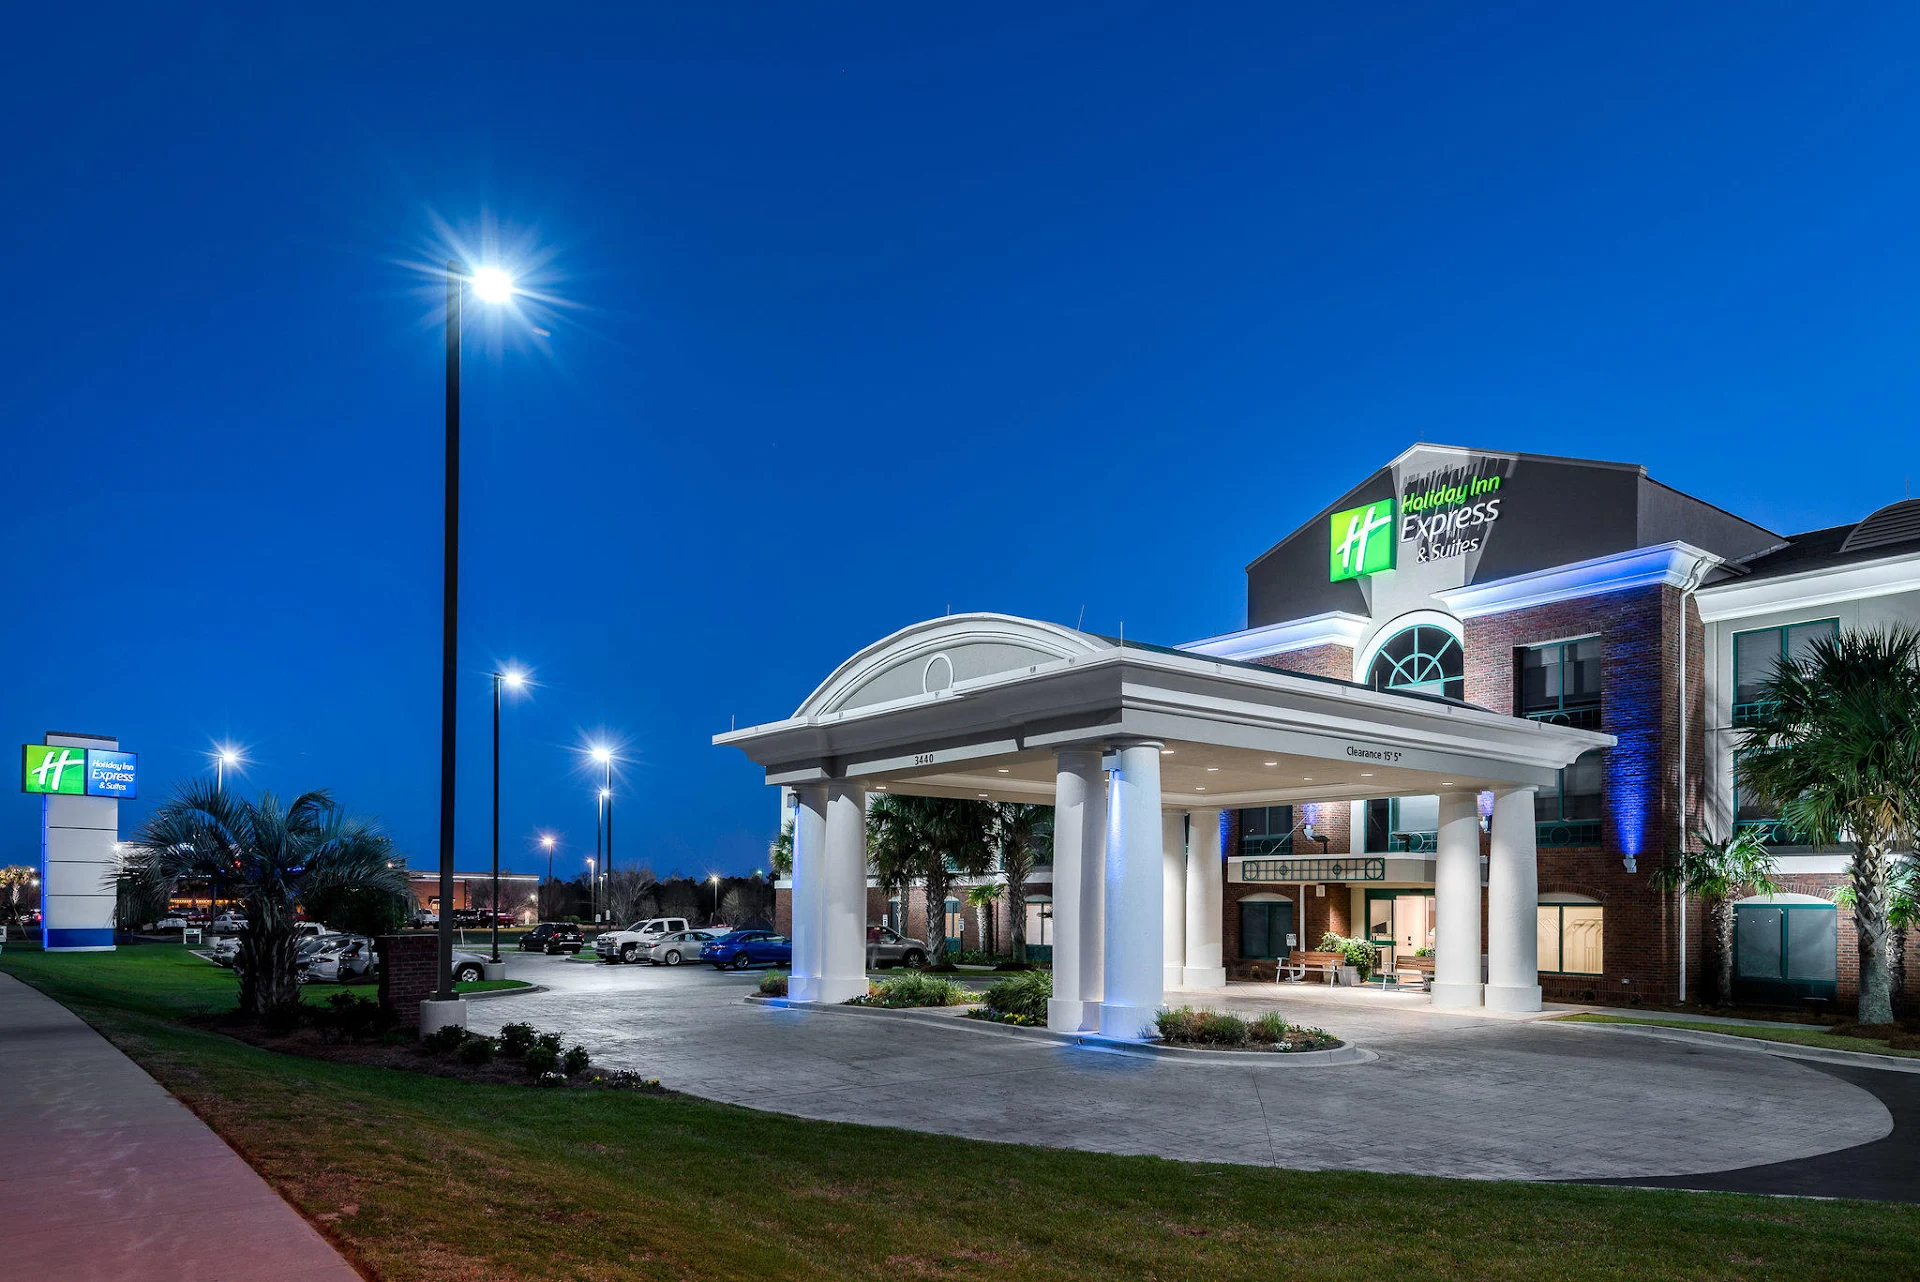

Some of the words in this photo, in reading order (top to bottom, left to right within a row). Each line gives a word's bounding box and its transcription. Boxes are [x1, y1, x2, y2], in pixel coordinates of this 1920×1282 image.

[1400, 484, 1469, 514] Holiday
[1470, 475, 1500, 496] Inn
[1400, 499, 1500, 543] Express
[1416, 547, 1429, 564] &
[1430, 538, 1479, 561] Suites
[914, 753, 934, 766] 3440
[1346, 745, 1382, 760] Clearance
[92, 760, 122, 771] Holiday
[122, 762, 134, 771] Inn
[92, 768, 135, 782] Express
[105, 782, 127, 791] Suites
